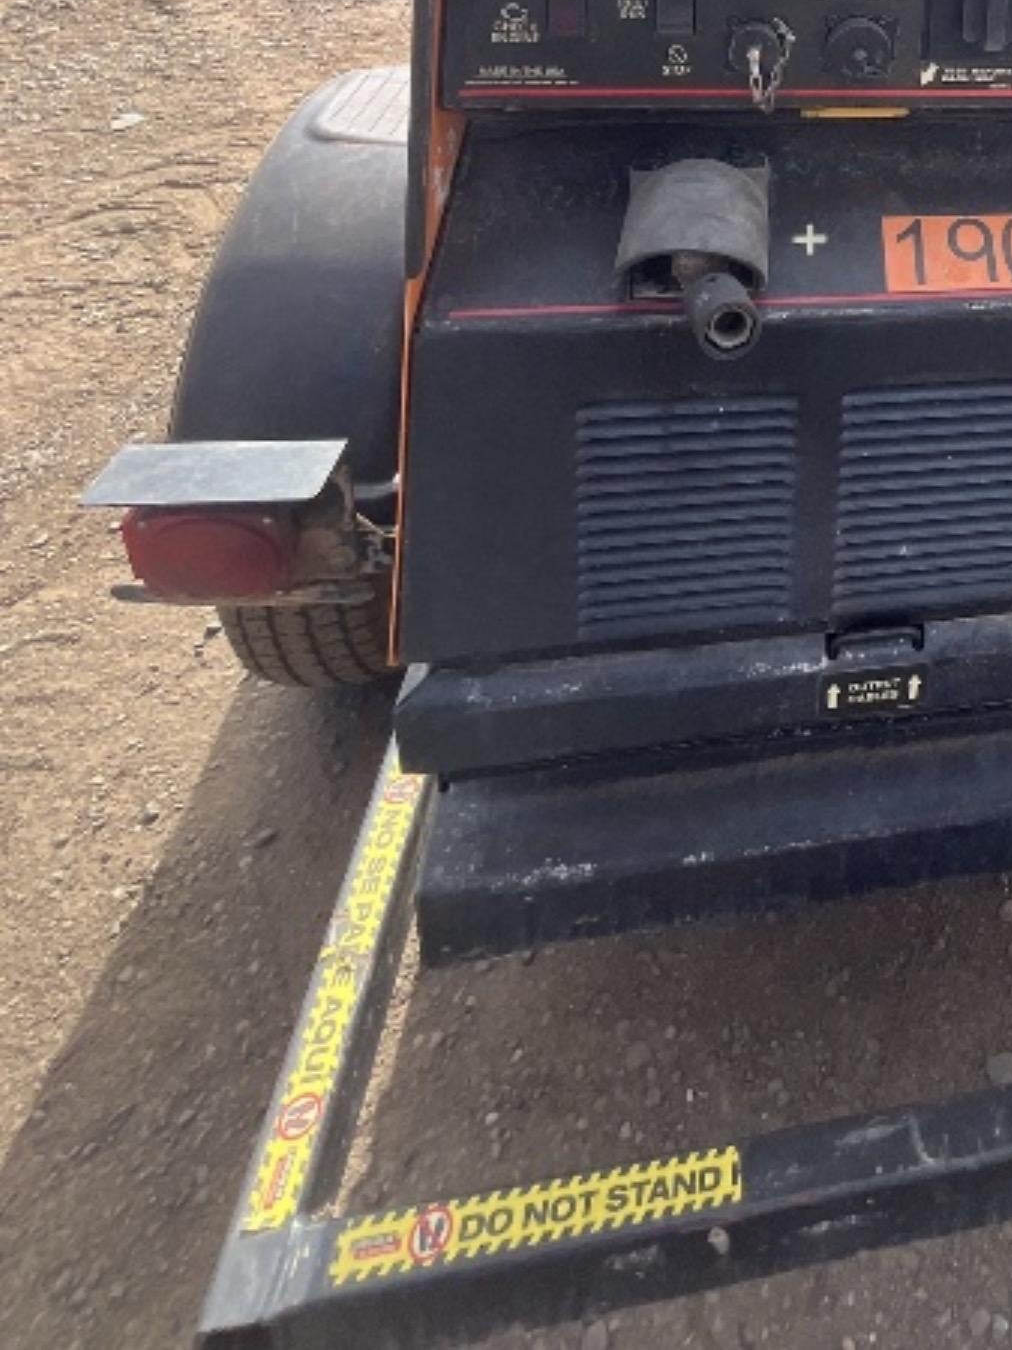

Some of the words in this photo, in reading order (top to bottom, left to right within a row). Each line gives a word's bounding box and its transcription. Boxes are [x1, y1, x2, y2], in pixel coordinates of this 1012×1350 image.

[458, 1208, 513, 1243] DO
[521, 1189, 599, 1230] NOT
[605, 1165, 723, 1213] STAND
